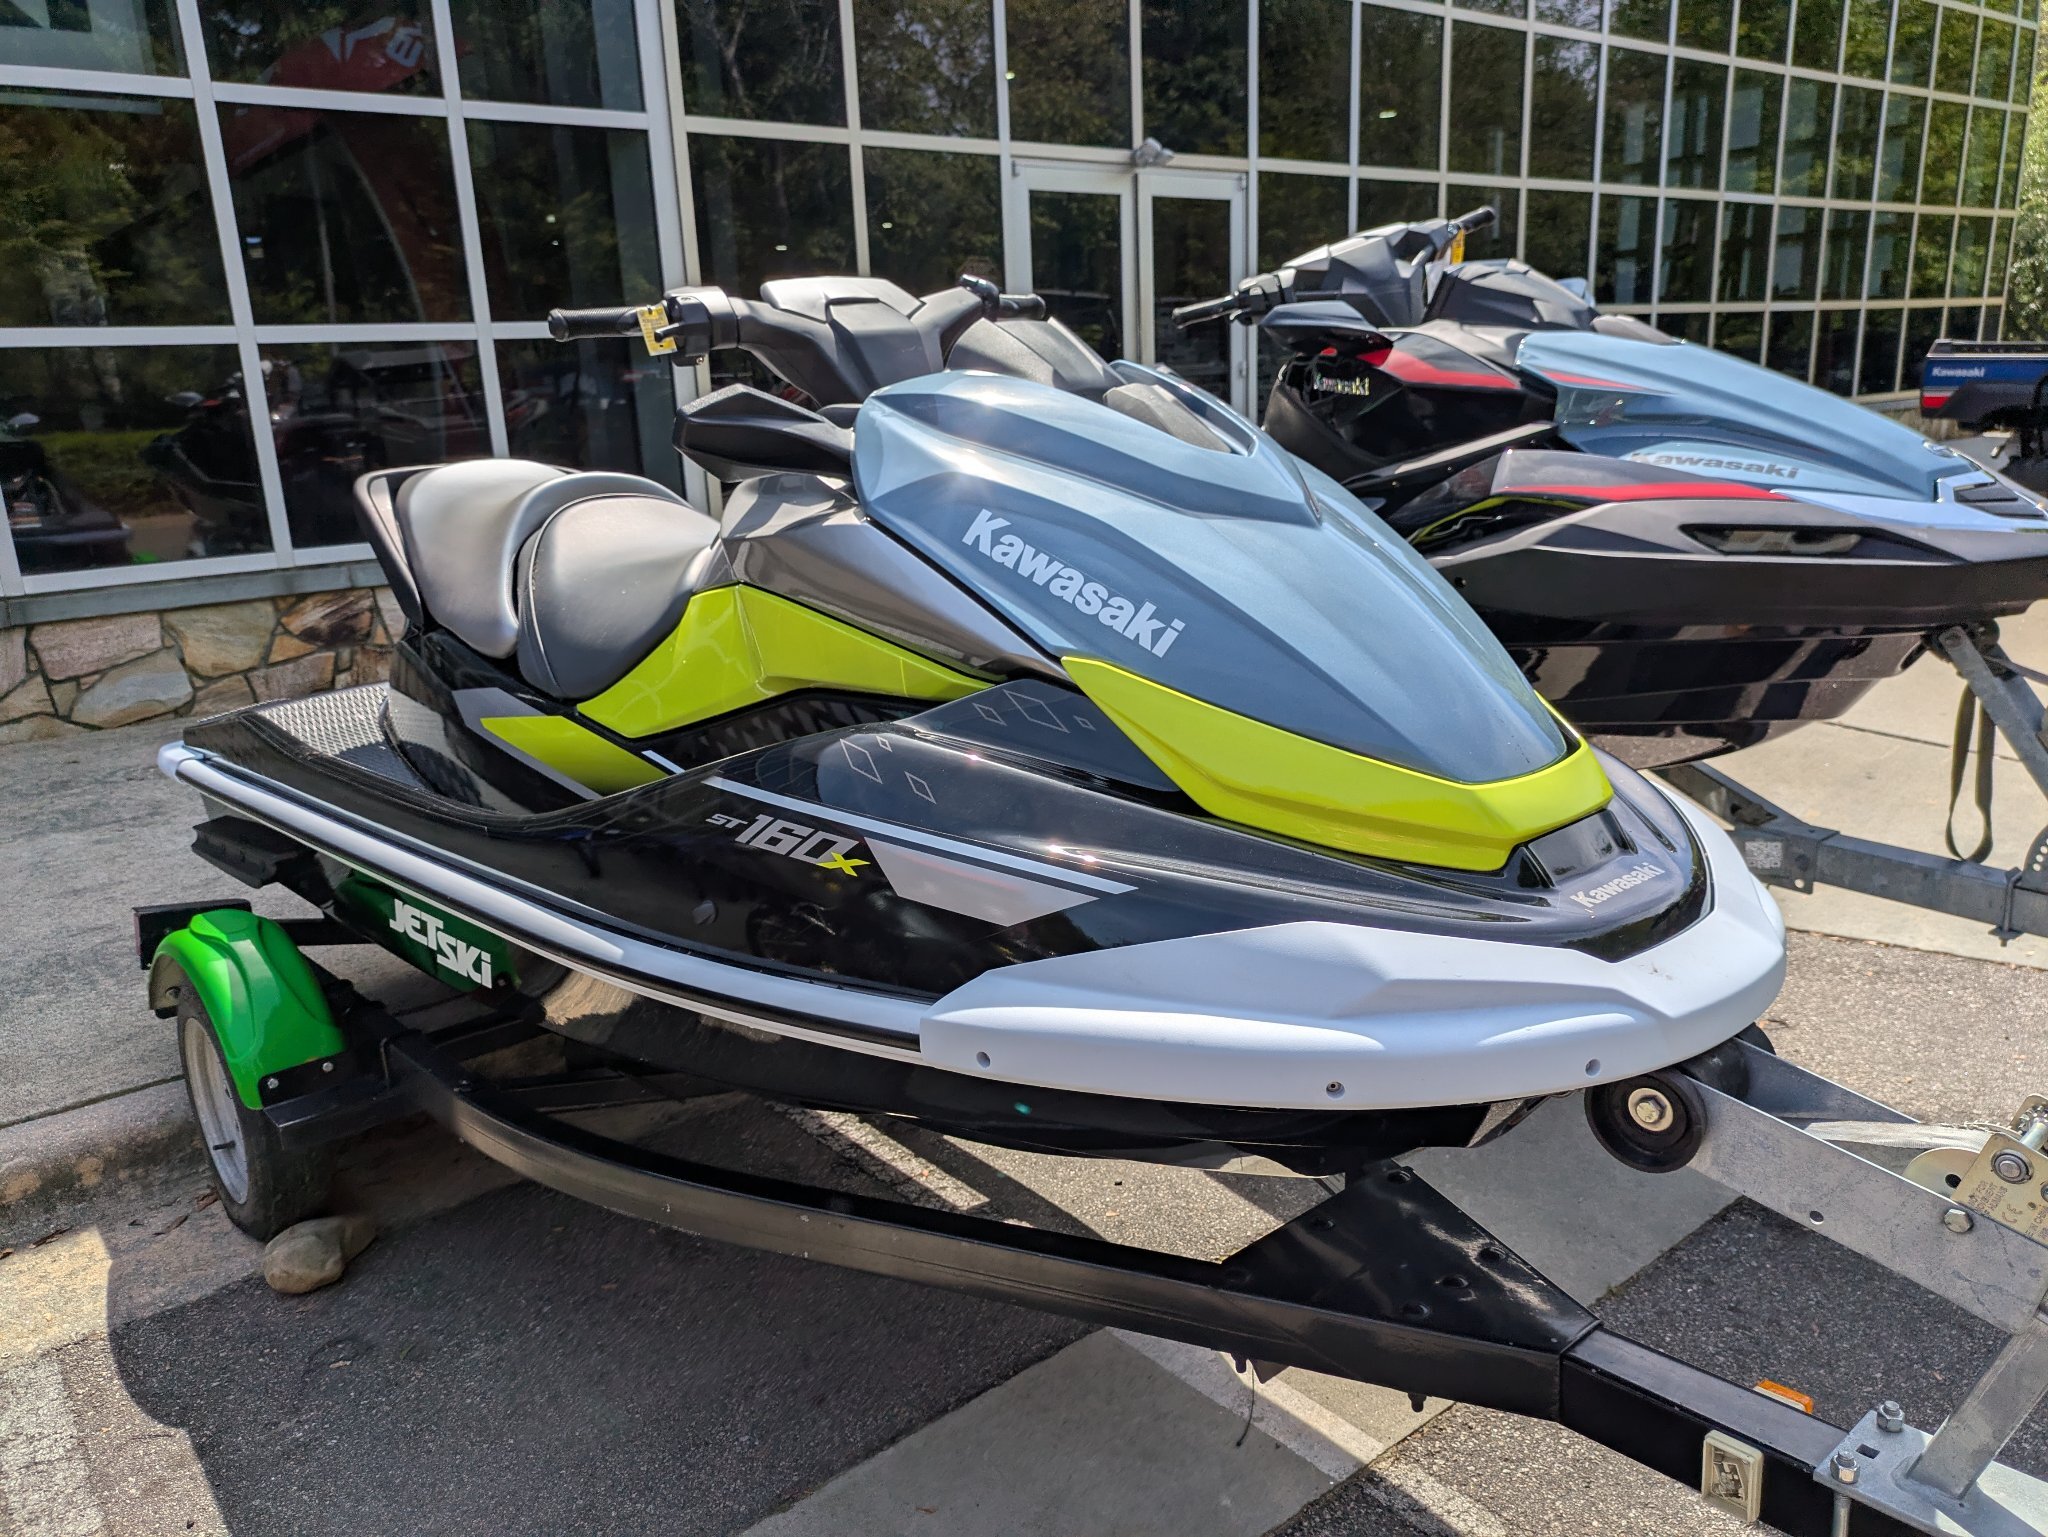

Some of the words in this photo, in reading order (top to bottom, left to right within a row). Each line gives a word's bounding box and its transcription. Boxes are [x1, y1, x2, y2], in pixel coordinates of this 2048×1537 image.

[1932, 366, 1985, 378] Kawasaki
[1630, 452, 1800, 479] Kawasaki
[962, 508, 1186, 658] Kawasaki
[705, 813, 748, 829] ST
[1569, 862, 1666, 908] Kawasaki
